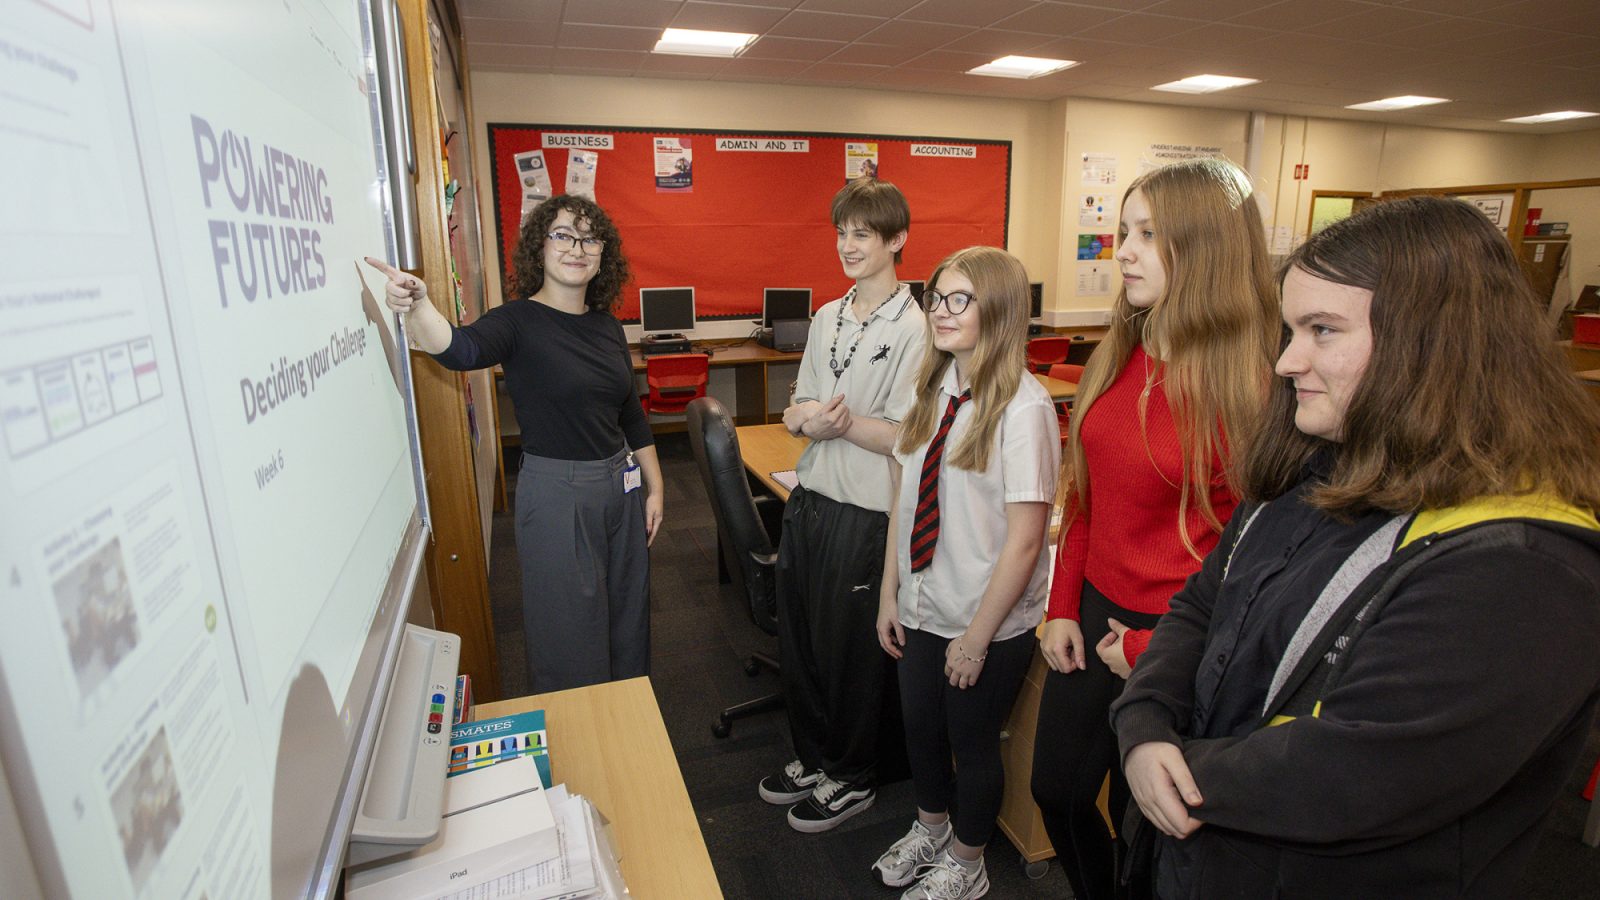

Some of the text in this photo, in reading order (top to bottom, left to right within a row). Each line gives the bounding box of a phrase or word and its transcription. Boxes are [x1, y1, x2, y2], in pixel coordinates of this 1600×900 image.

[547, 135, 609, 147] BUSINESS
[720, 140, 804, 150] ADMIN AND IT
[915, 146, 973, 156] ACCOUNTING
[190, 113, 333, 224] POWERING
[208, 219, 326, 309] FUTURES
[240, 327, 366, 425] Deciding your Challenge
[254, 448, 285, 490] Week 6
[449, 868, 468, 880] iPad
